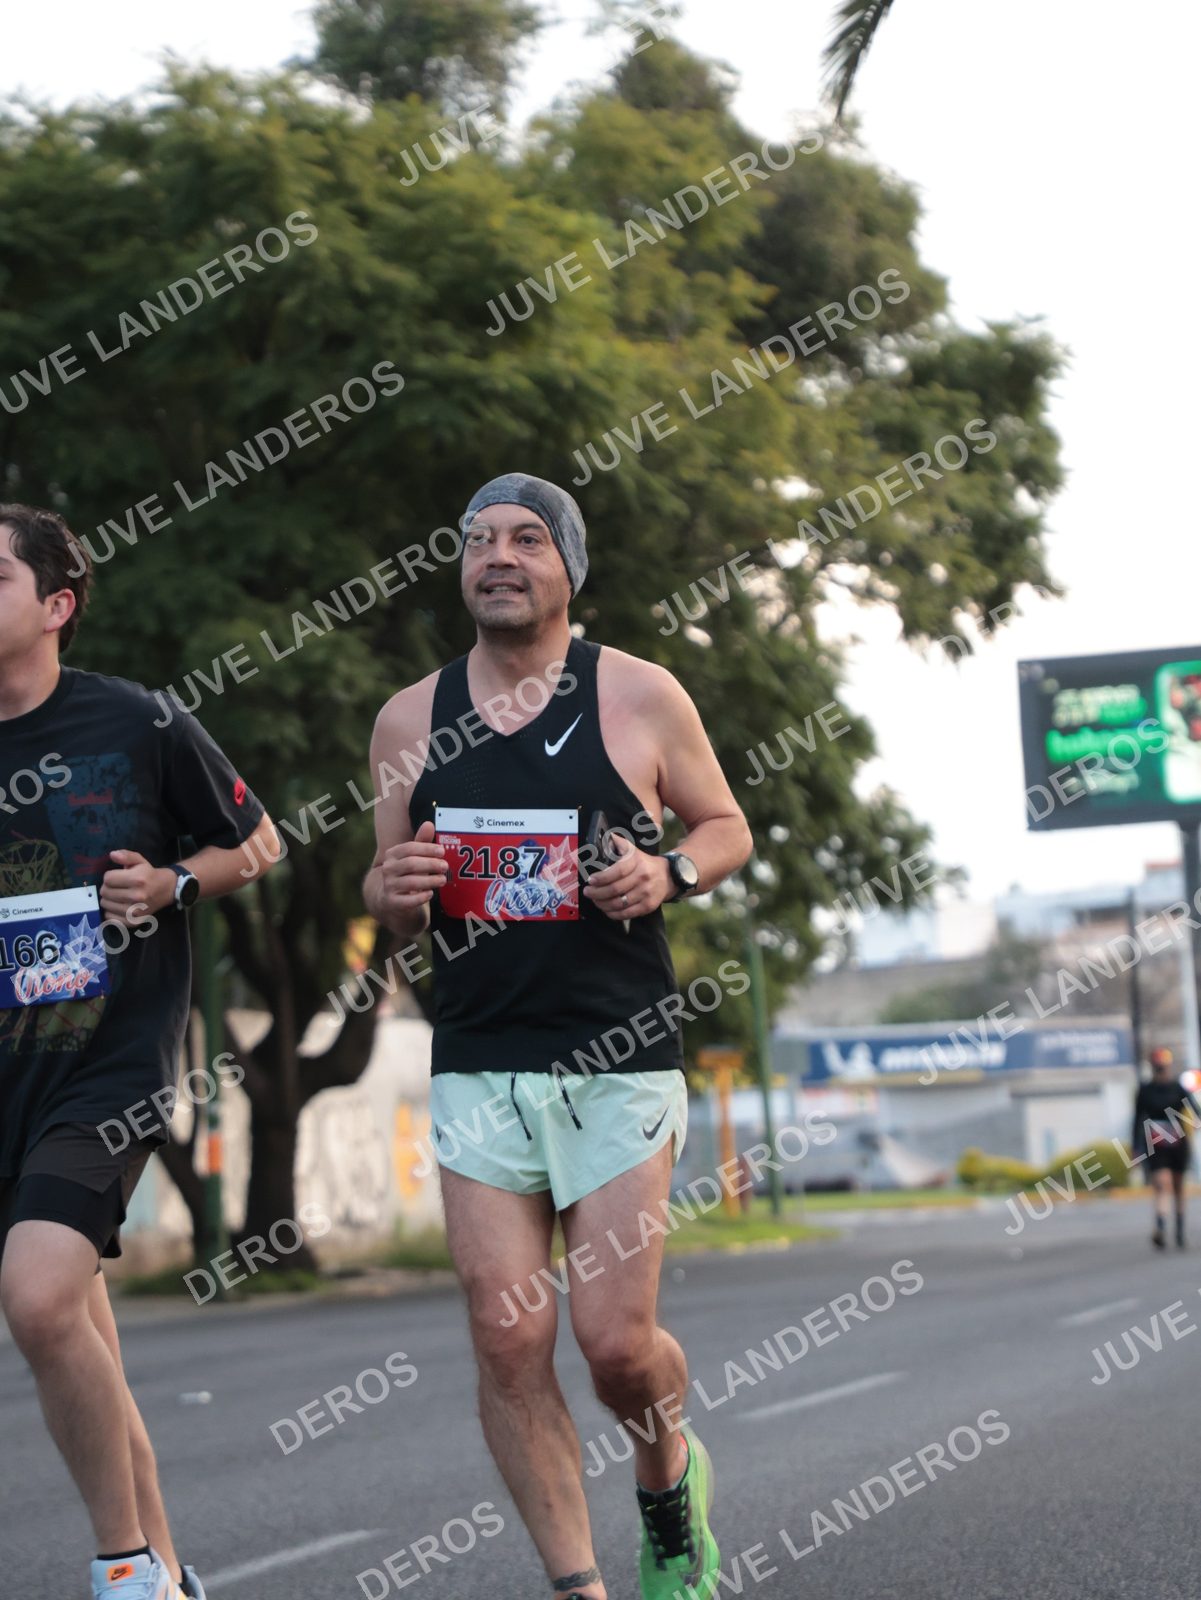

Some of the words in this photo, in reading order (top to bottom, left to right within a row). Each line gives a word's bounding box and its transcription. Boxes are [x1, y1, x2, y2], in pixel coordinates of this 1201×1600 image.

[487, 818, 525, 828] Cinemex
[458, 845, 546, 881] 2187
[12, 906, 43, 916] Cinemex
